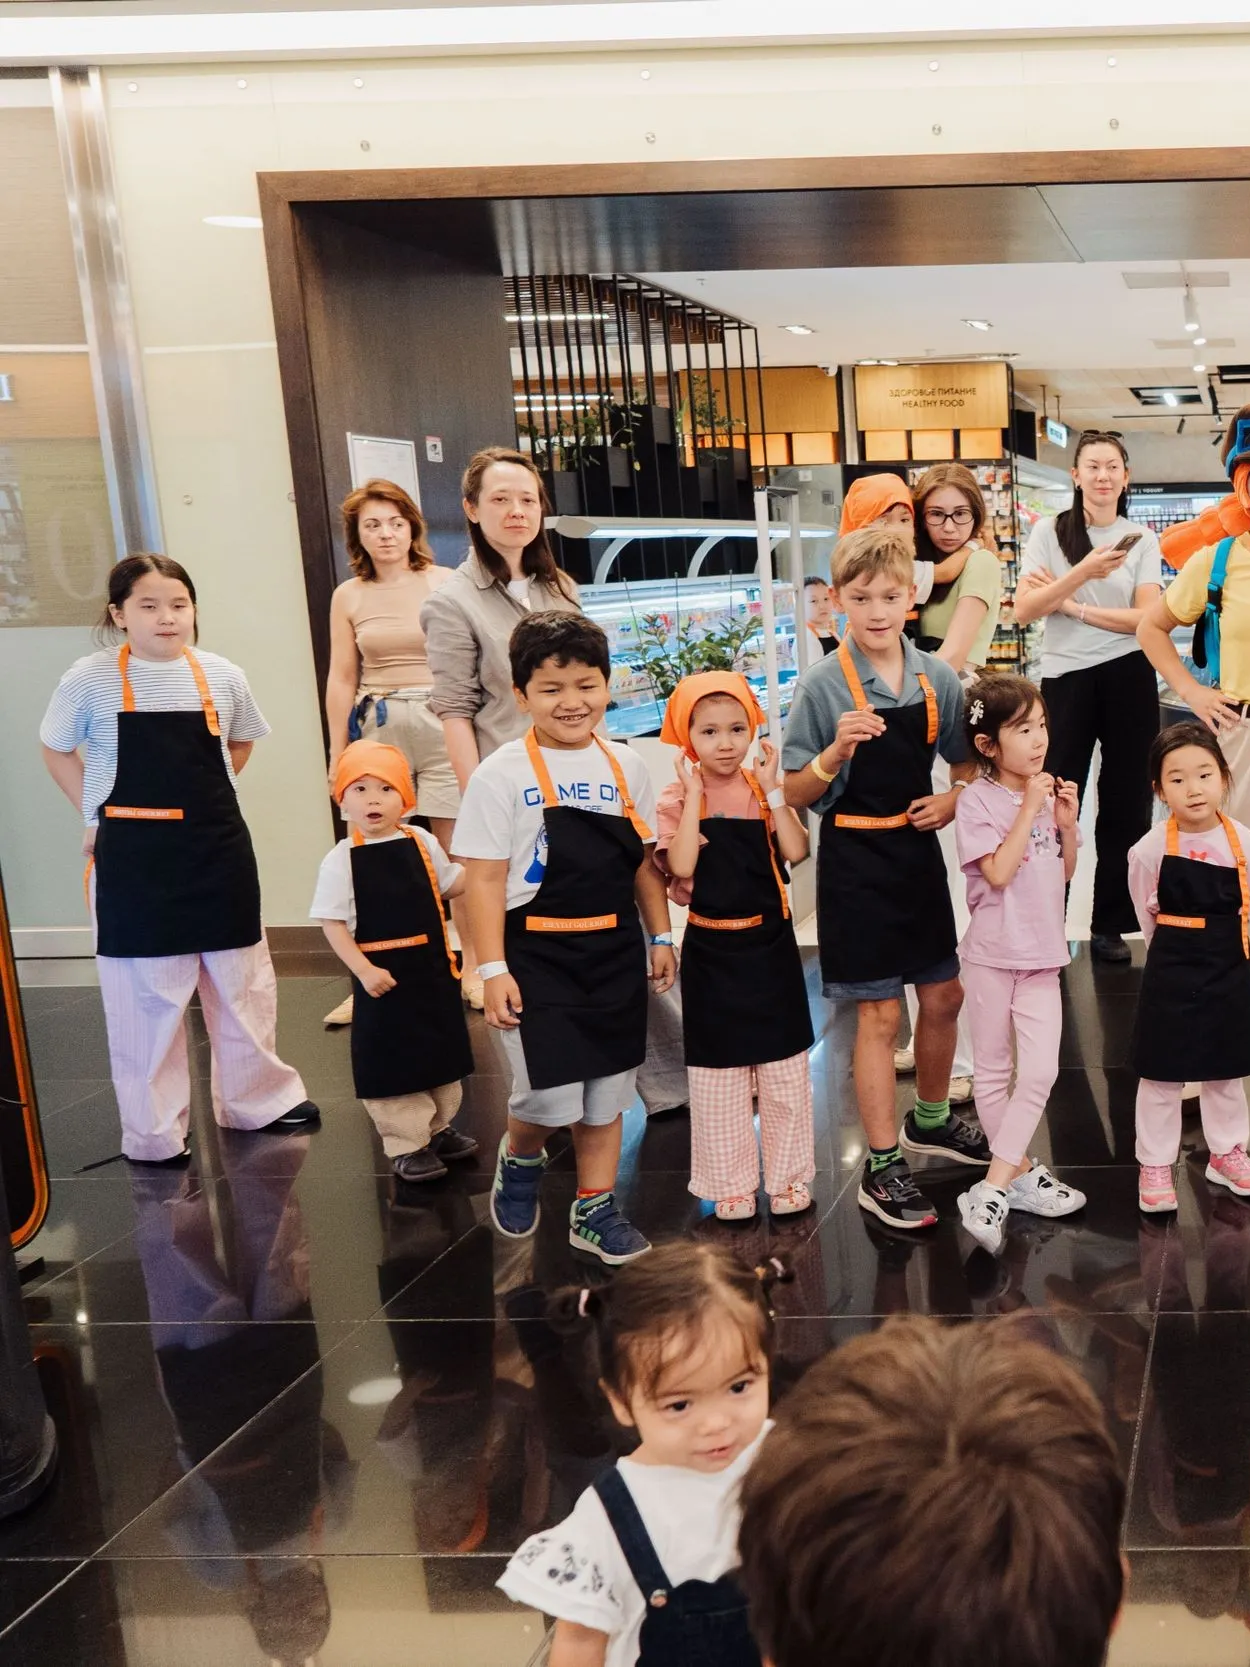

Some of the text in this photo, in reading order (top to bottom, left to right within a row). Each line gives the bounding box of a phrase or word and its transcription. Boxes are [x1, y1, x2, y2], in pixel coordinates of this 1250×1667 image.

[937, 387, 977, 397] ПИТАНИЕ
[902, 398, 966, 408] HEALTHY FOOD
